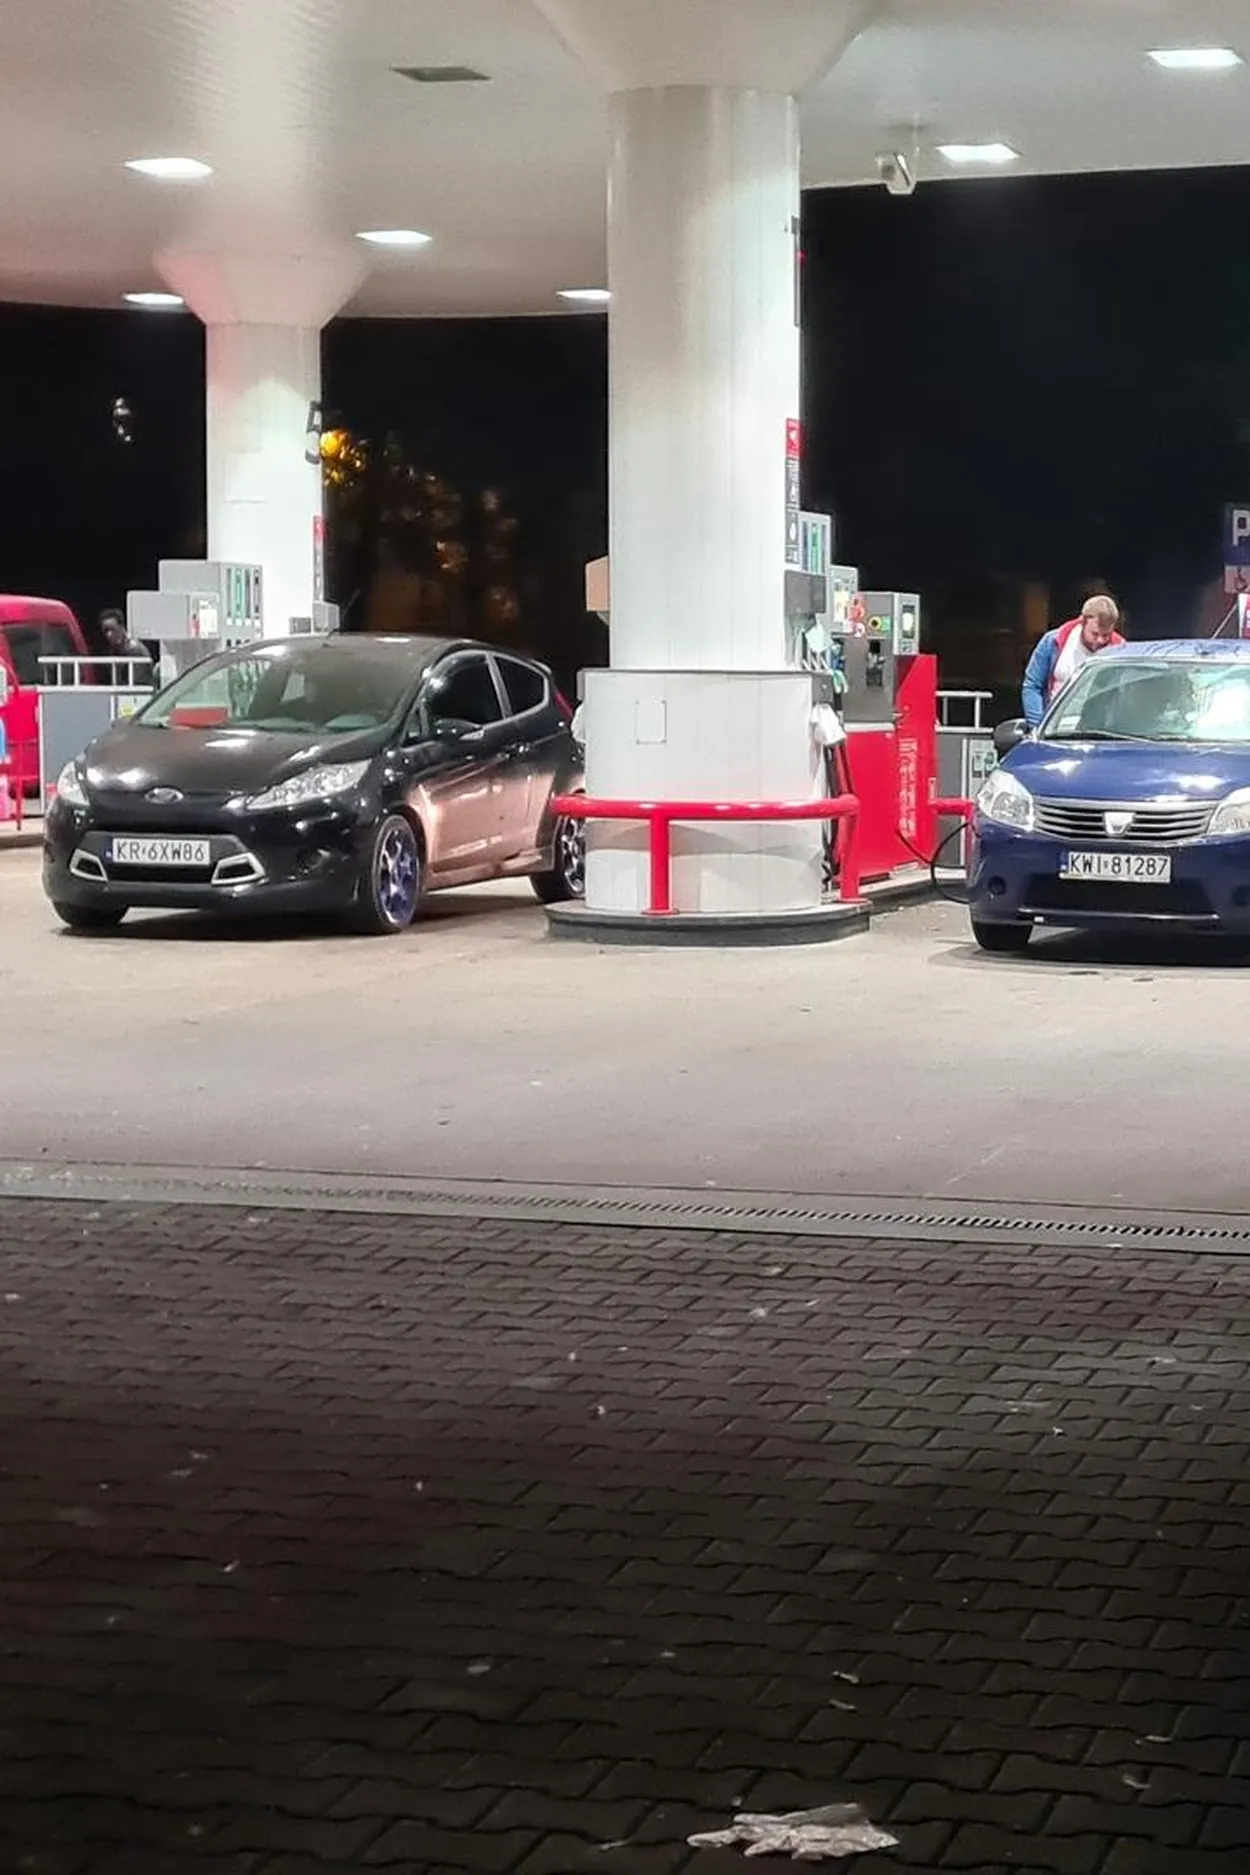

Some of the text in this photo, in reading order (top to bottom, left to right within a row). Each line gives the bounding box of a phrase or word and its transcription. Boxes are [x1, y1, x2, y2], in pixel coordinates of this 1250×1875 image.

[116, 841, 140, 860] KR
[1070, 854, 1169, 876] KWI 81287
